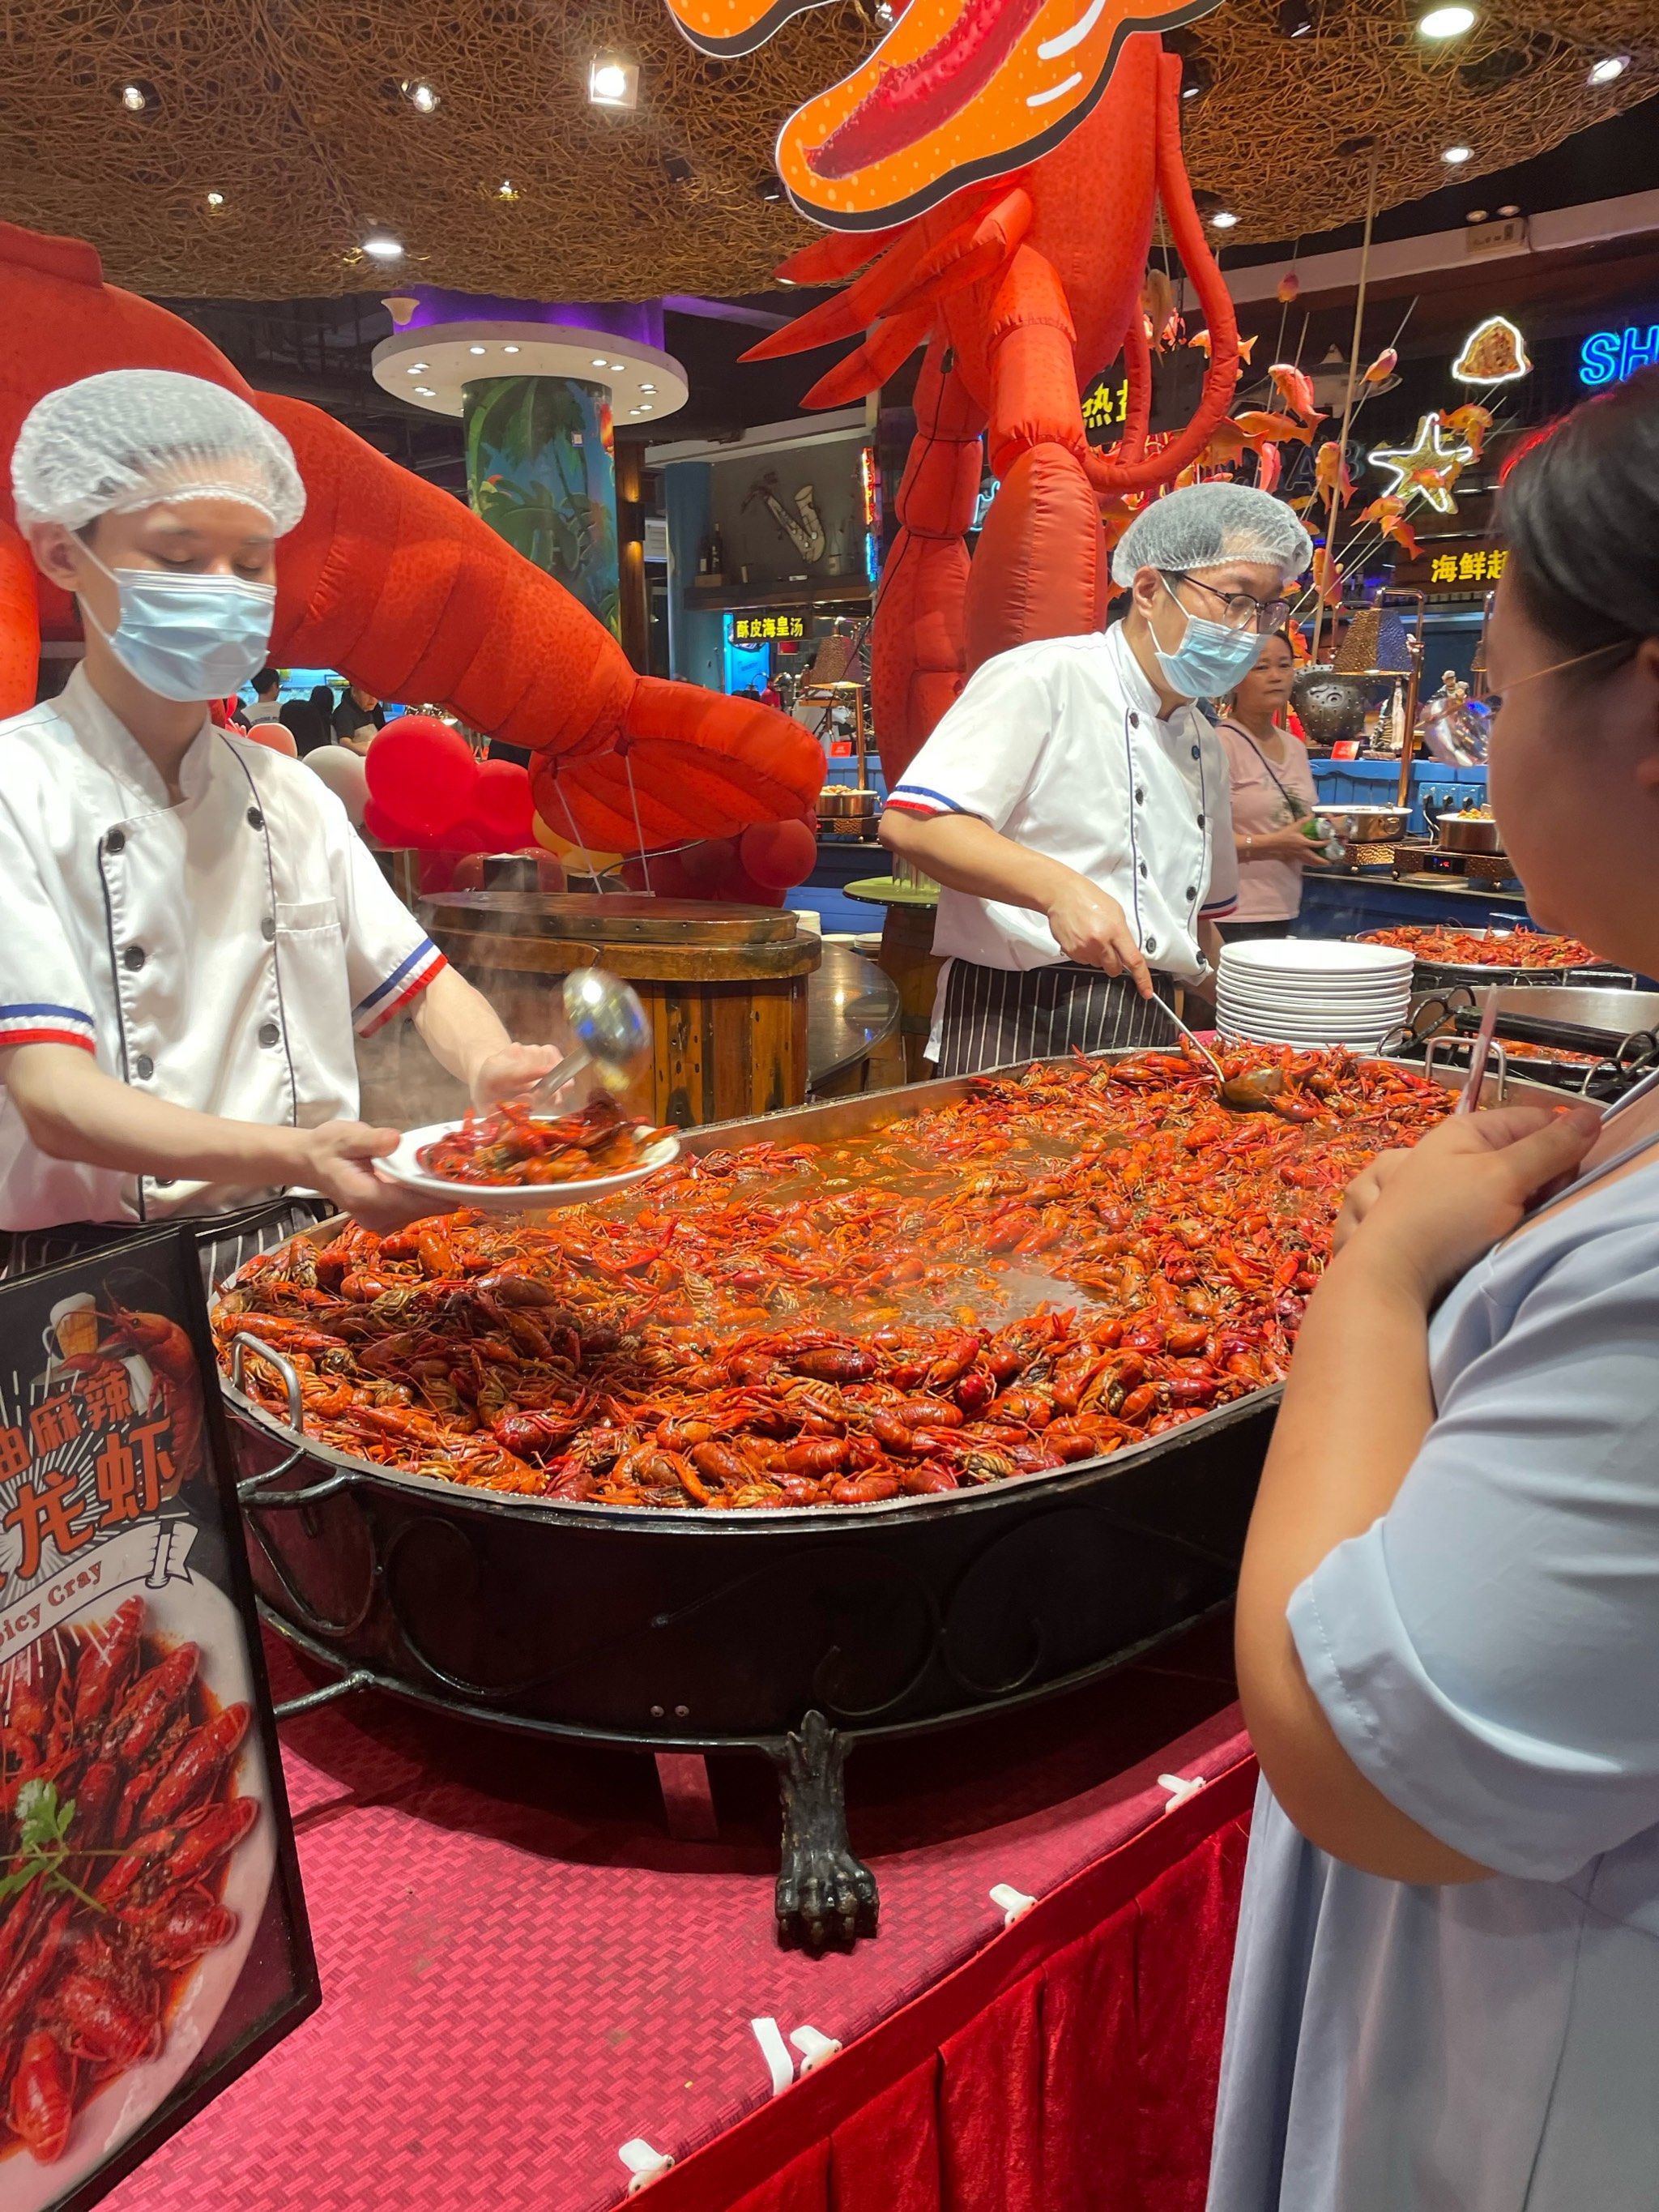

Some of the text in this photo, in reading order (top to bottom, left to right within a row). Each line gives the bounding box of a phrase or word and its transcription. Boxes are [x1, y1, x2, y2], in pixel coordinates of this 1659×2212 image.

[736, 615, 804, 638] 酥皮海皇汤
[0, 1416, 176, 1590] 龙虾
[48, 1561, 102, 1607] Cray
